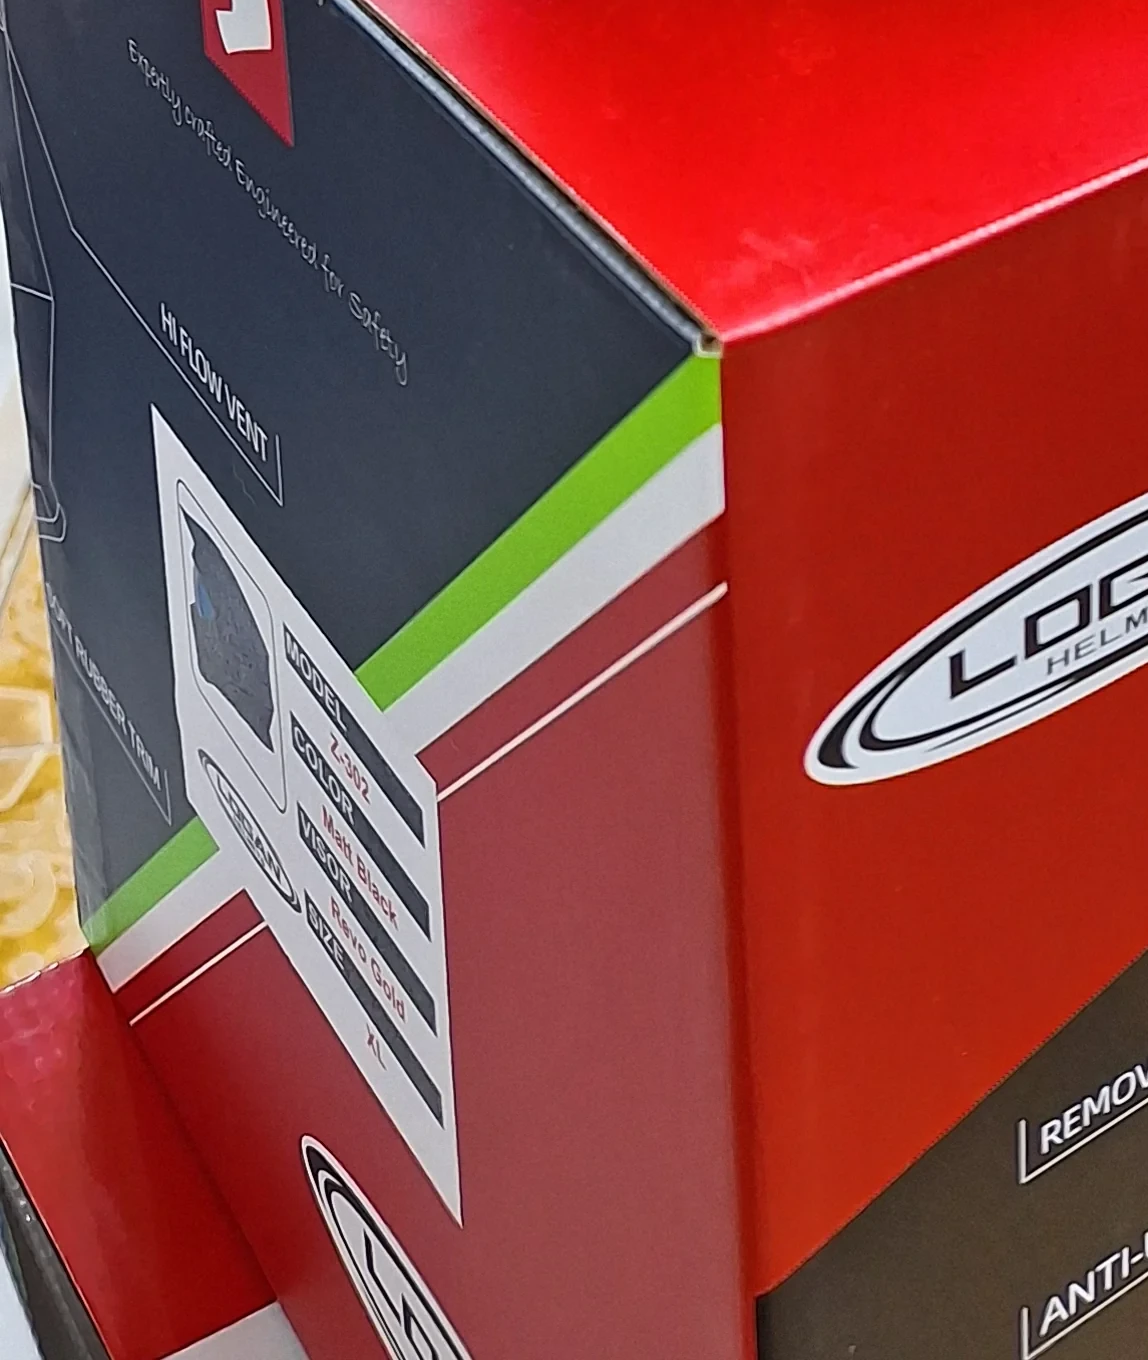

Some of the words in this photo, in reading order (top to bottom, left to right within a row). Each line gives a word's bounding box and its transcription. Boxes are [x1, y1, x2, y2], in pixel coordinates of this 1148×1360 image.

[128, 39, 182, 126] Expertly
[184, 106, 233, 171] crafted
[235, 159, 318, 269] Engineered
[320, 253, 344, 298] for
[349, 292, 408, 386] Safety
[161, 302, 178, 346] HI
[179, 326, 222, 403] FLOW
[224, 383, 268, 461] VENT
[286, 630, 348, 732] MODEL
[294, 725, 356, 825] COLOR
[330, 731, 371, 805] Z-302
[300, 811, 353, 903] VISOR
[322, 804, 354, 867] Matt
[356, 854, 399, 931] Black
[308, 902, 346, 970] SIZE
[330, 895, 367, 964] Revo
[371, 956, 405, 1024] Gold
[366, 1023, 387, 1071] XL
